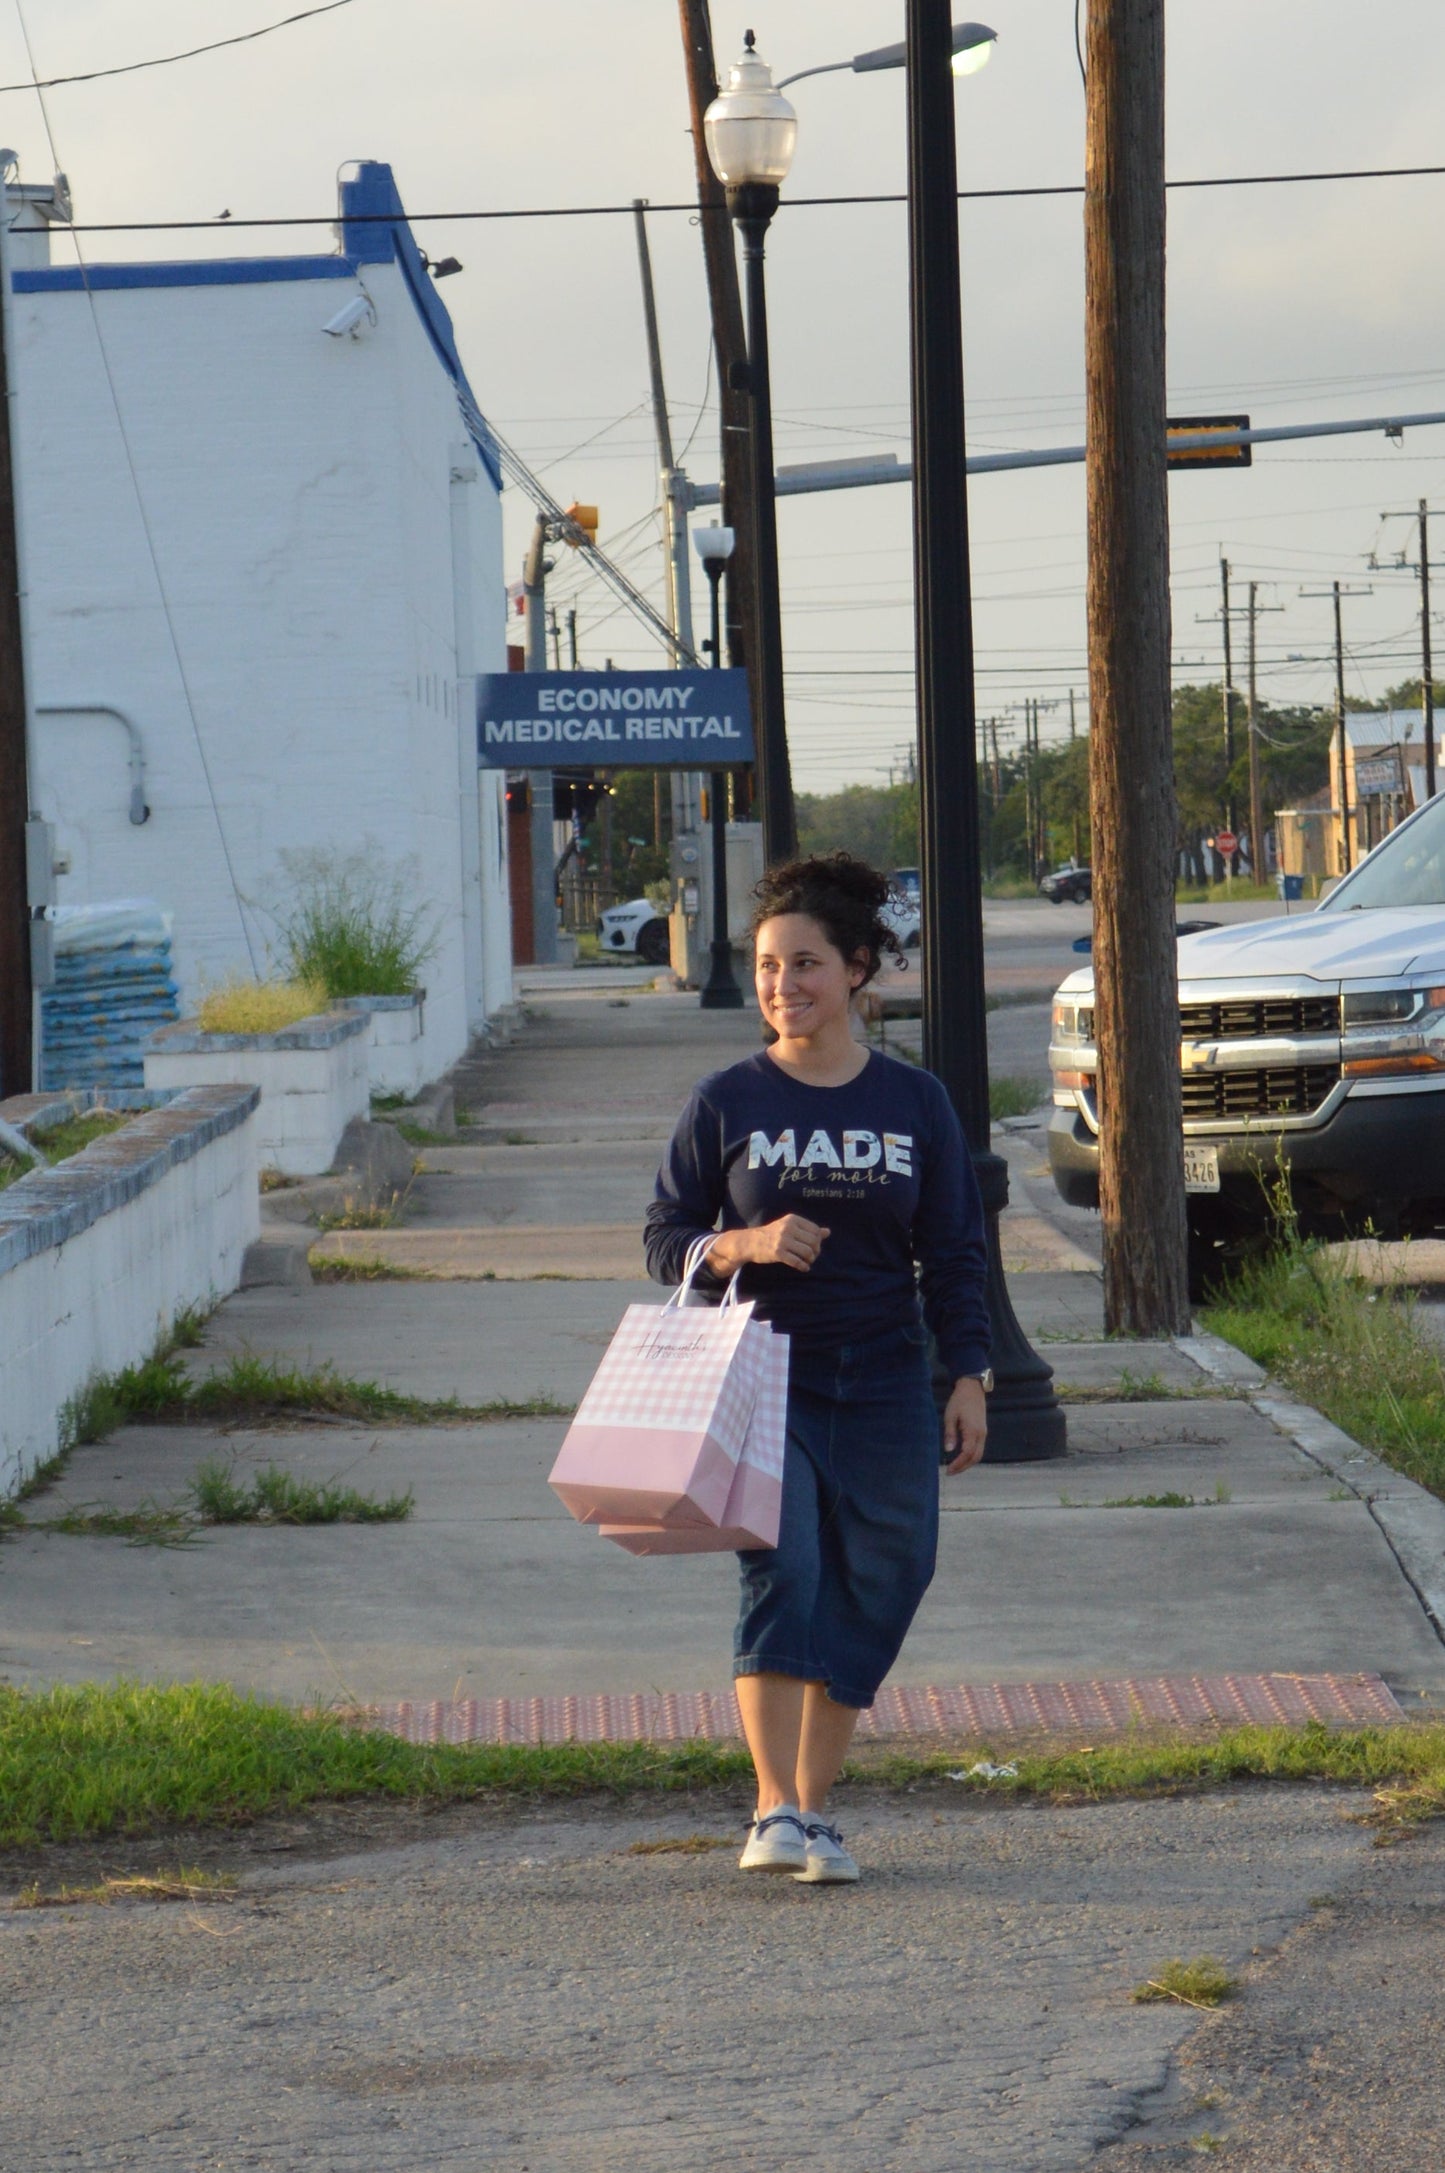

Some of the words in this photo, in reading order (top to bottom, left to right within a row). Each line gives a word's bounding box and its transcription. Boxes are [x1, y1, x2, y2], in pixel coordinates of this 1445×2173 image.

[537, 687, 695, 712] ECONOMY
[484, 718, 621, 743] MEDICAL
[625, 716, 741, 740] RENTAL
[747, 1128, 913, 1177] MADE
[777, 1166, 818, 1190] for
[826, 1168, 893, 1185] more
[802, 1187, 843, 1199] Ephesians
